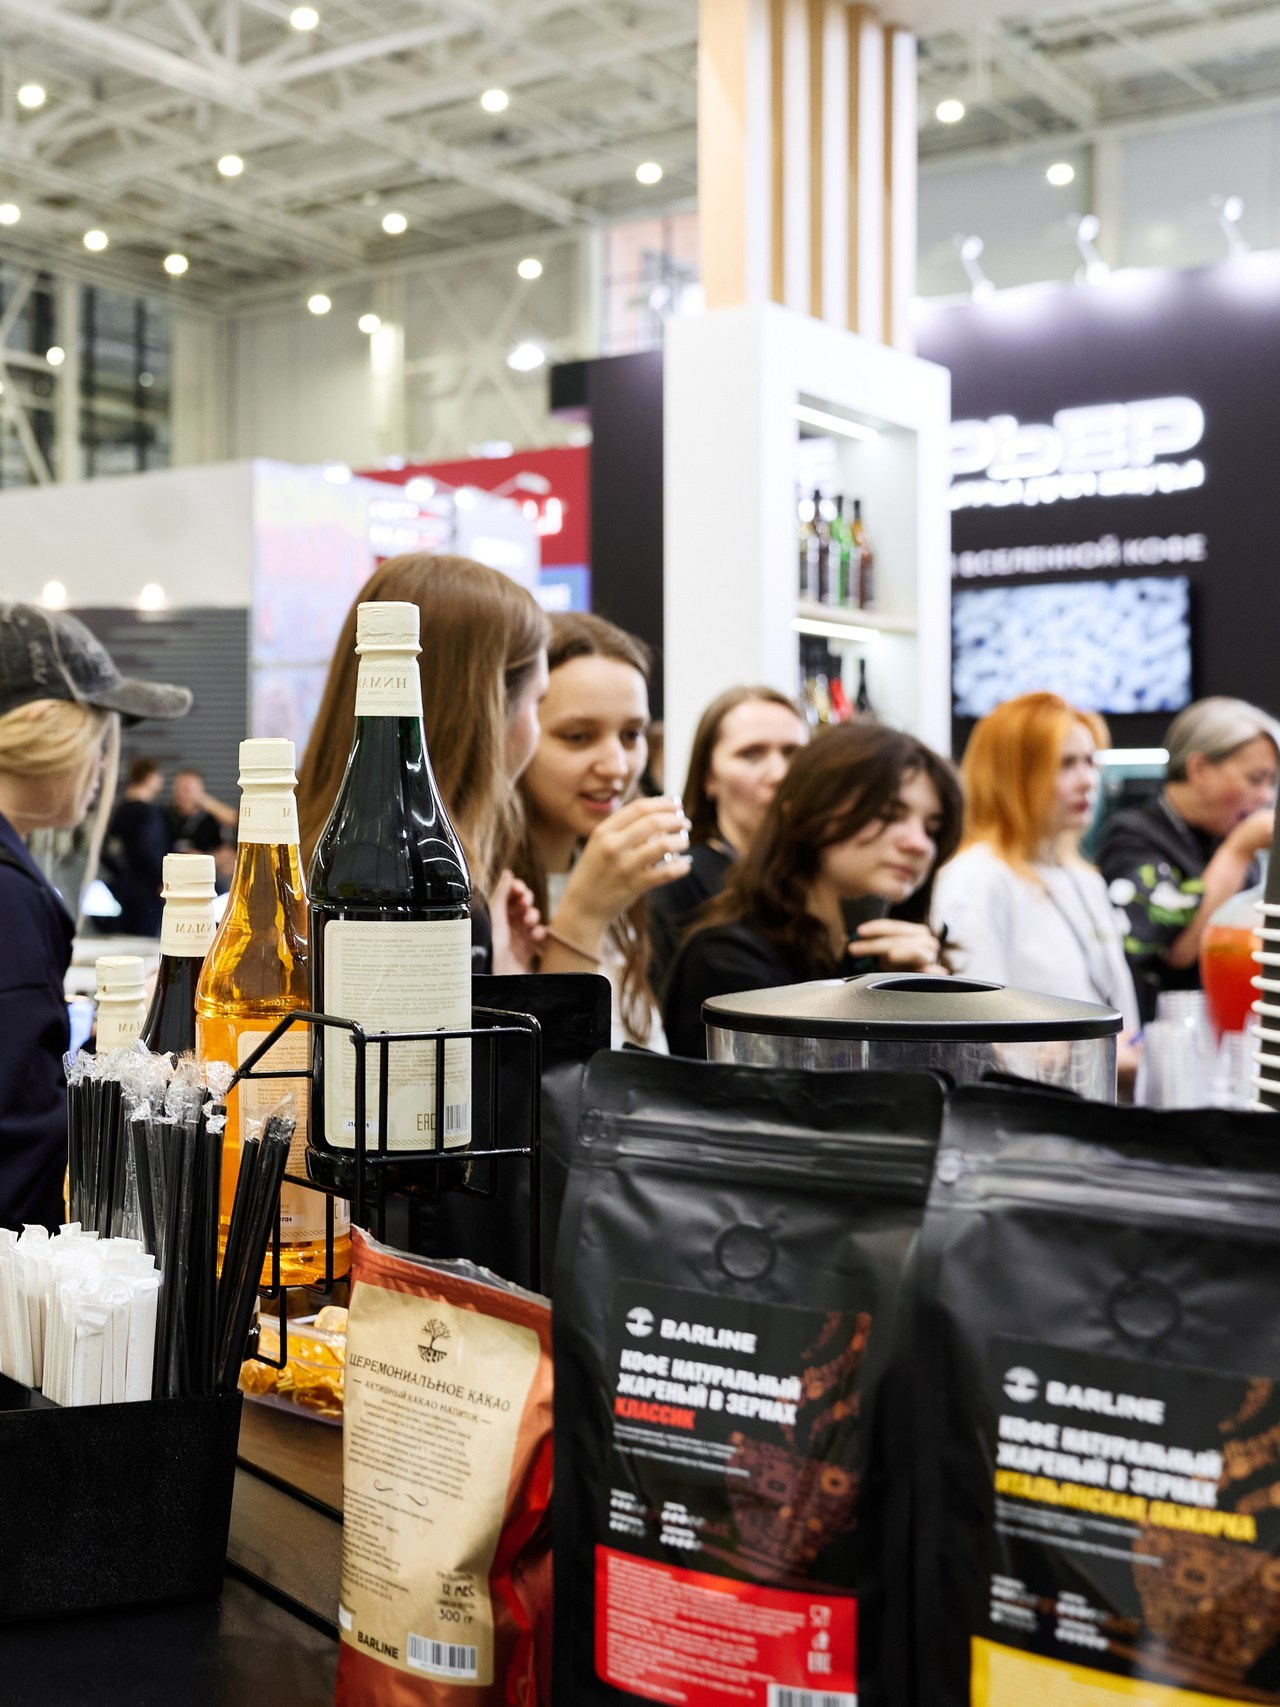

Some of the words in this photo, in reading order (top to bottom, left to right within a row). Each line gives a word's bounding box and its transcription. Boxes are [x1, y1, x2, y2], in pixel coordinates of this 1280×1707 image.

[1122, 532, 1208, 567] КОФЕ
[659, 1318, 757, 1354] BARLINE
[349, 1352, 465, 1399] ЦЕРЕМОНИАЛЬНОЕ
[469, 1389, 511, 1412] КАКАО
[619, 1349, 670, 1377] КОФЕ
[671, 1358, 802, 1400] НАТУРАЛЬНЫЙ
[364, 1380, 408, 1401] АКТИВНЫЙ
[408, 1395, 438, 1411] КАКАО
[439, 1404, 479, 1423] НАПИТОК
[614, 1396, 696, 1430] КЛАССИК
[616, 1372, 708, 1408] ЖАРЕНЫЙ
[709, 1389, 724, 1411] В
[725, 1393, 798, 1425] ЗЕРНАХ
[1046, 1380, 1166, 1425] BARLINE
[357, 1631, 399, 1660] BARLINE
